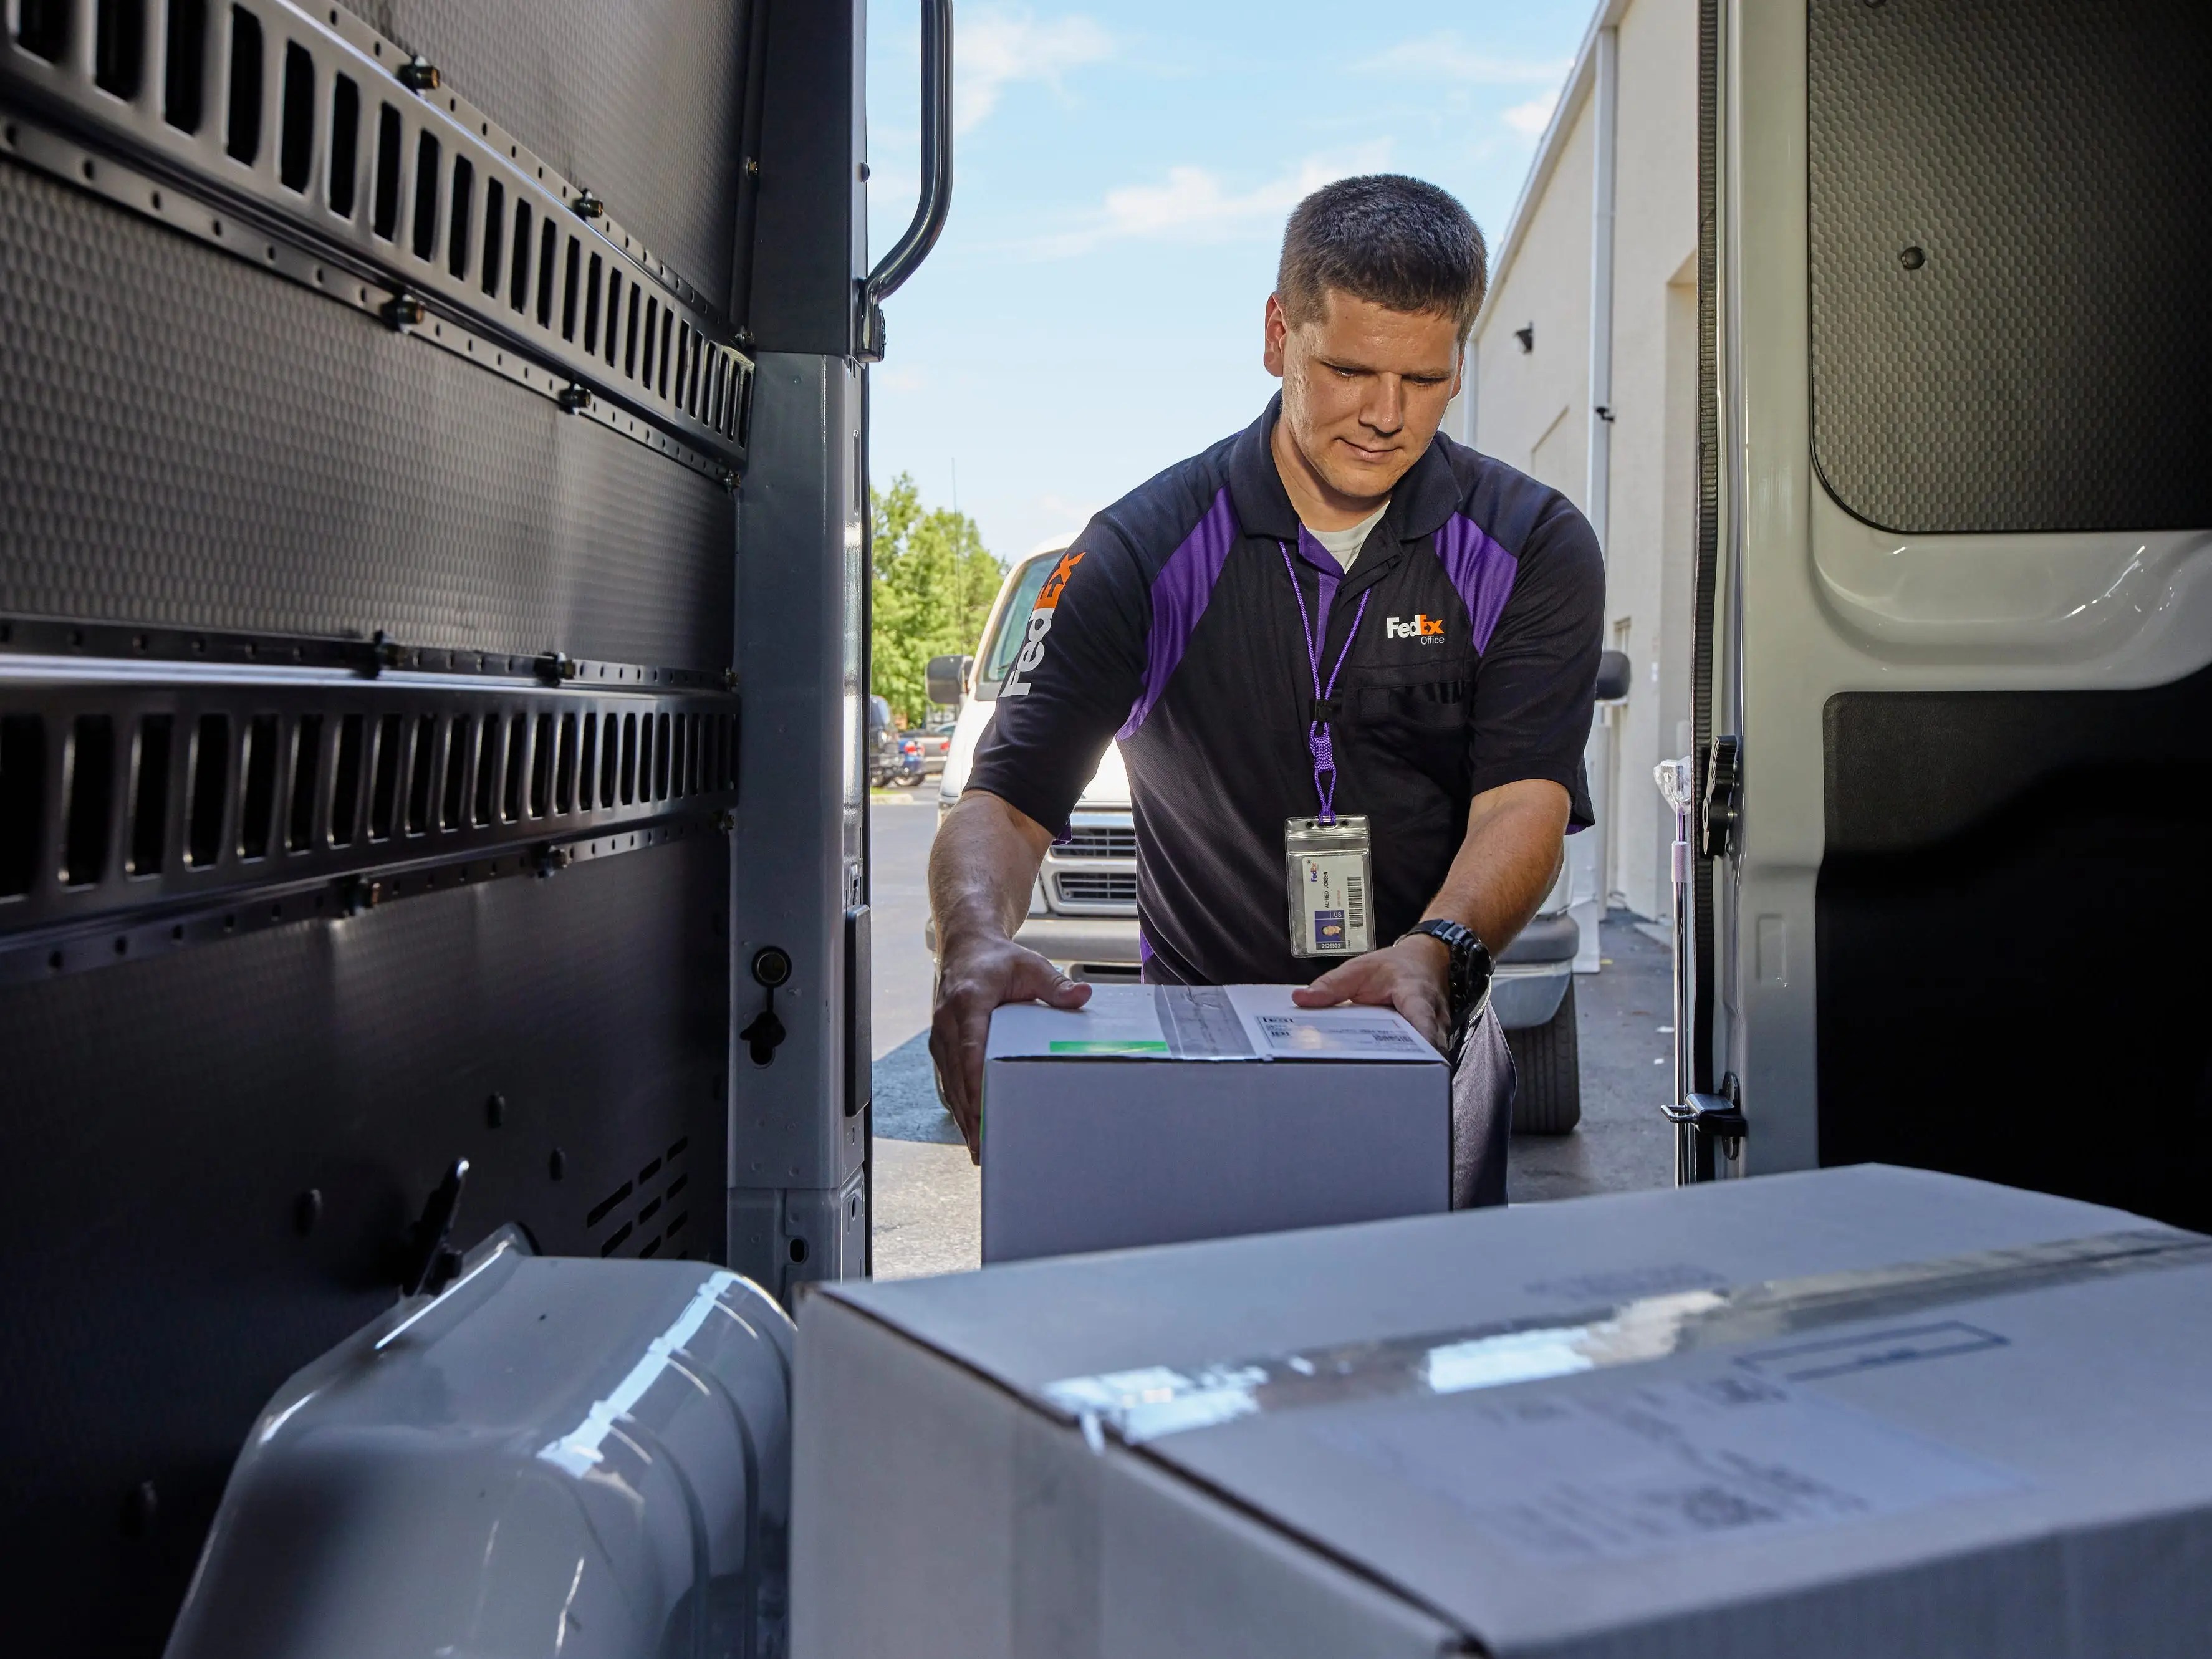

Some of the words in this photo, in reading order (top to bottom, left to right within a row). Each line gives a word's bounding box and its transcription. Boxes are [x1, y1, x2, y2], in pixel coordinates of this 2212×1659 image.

[999, 552, 1086, 697] FedEx
[1387, 614, 1444, 638] FedEx
[1421, 636, 1445, 645] Office
